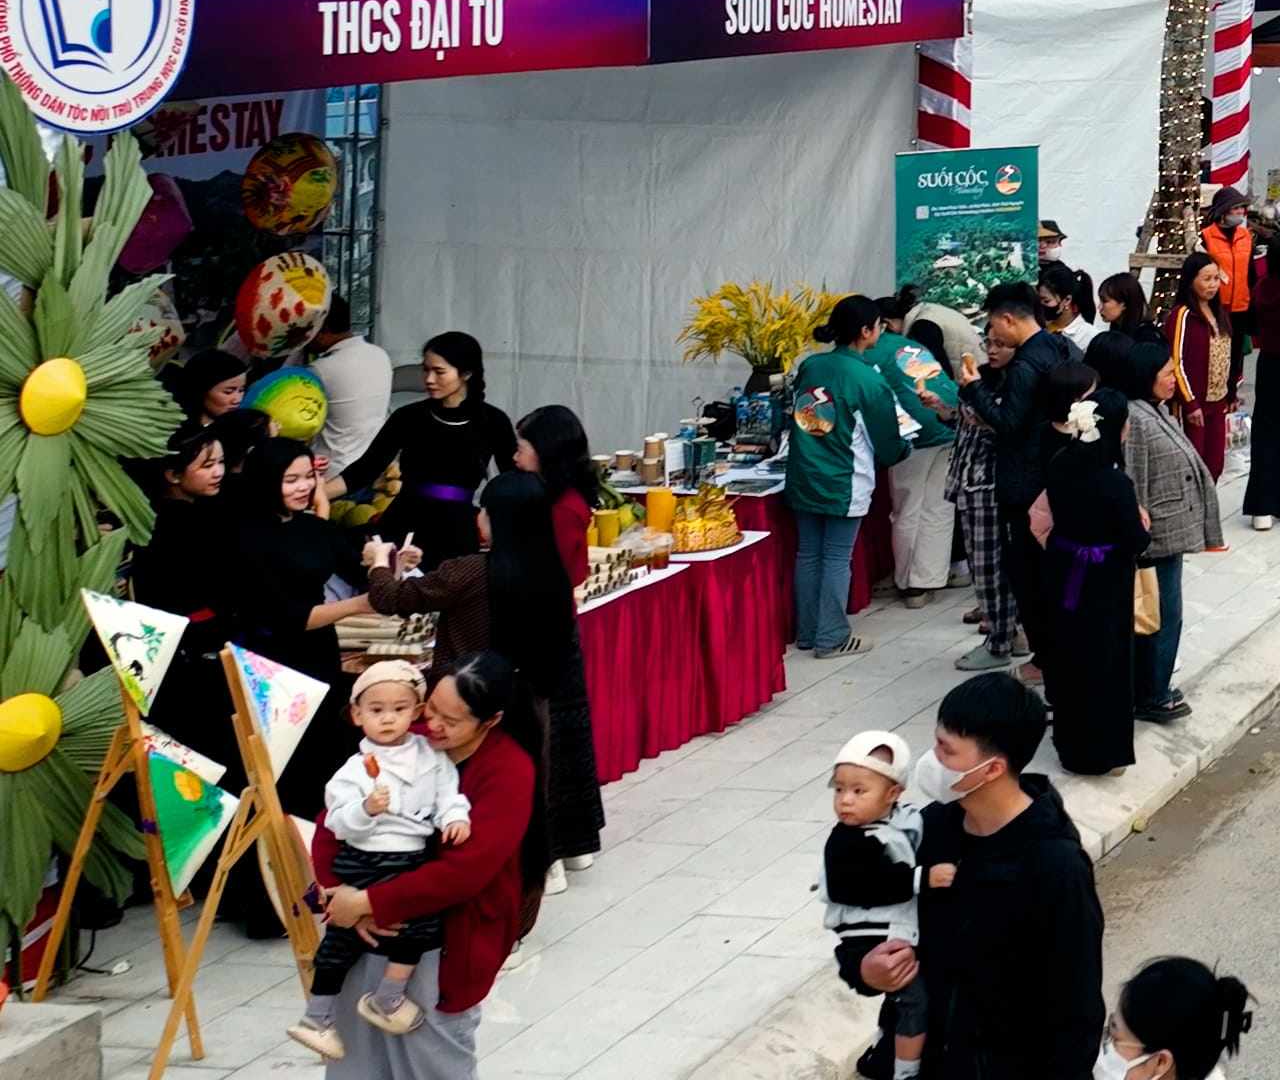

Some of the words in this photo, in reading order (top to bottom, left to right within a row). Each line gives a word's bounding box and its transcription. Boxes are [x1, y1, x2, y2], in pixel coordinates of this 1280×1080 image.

[318, 0, 400, 55] THCS
[156, 99, 284, 158] MESTAY
[918, 167, 953, 189] SUỐI
[955, 165, 990, 187] CỐC
